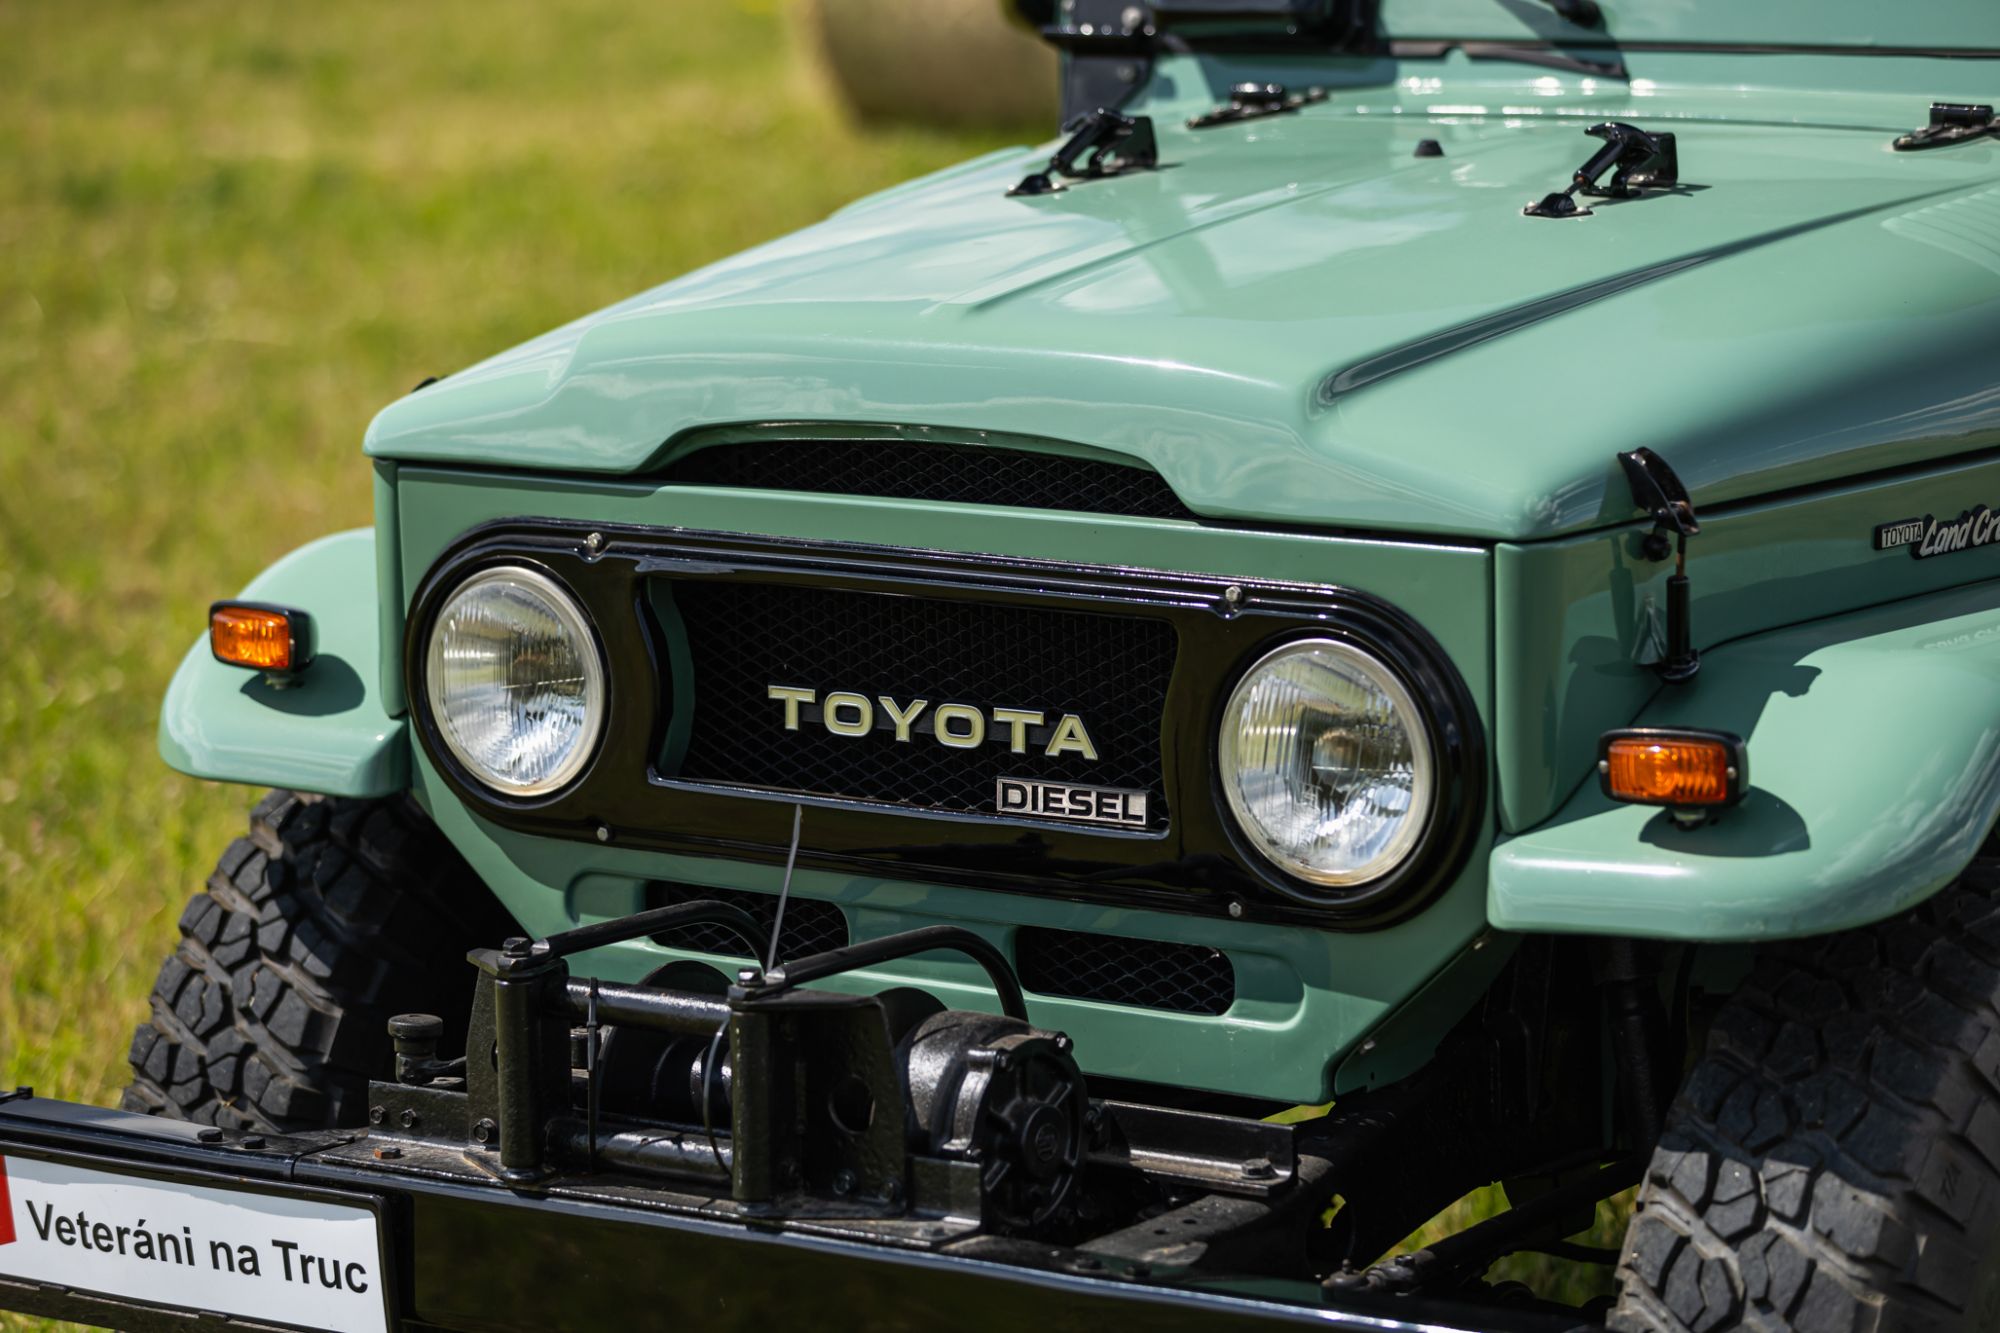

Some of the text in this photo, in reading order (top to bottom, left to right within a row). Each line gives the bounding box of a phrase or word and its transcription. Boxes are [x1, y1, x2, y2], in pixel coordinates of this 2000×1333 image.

[1883, 523, 1922, 547] TOYOTA
[1919, 516, 1974, 557] Land
[767, 684, 1098, 761] TOYOTA
[1000, 779, 1144, 823] DIESEL
[25, 1199, 369, 1294] Veteráni na Truc
